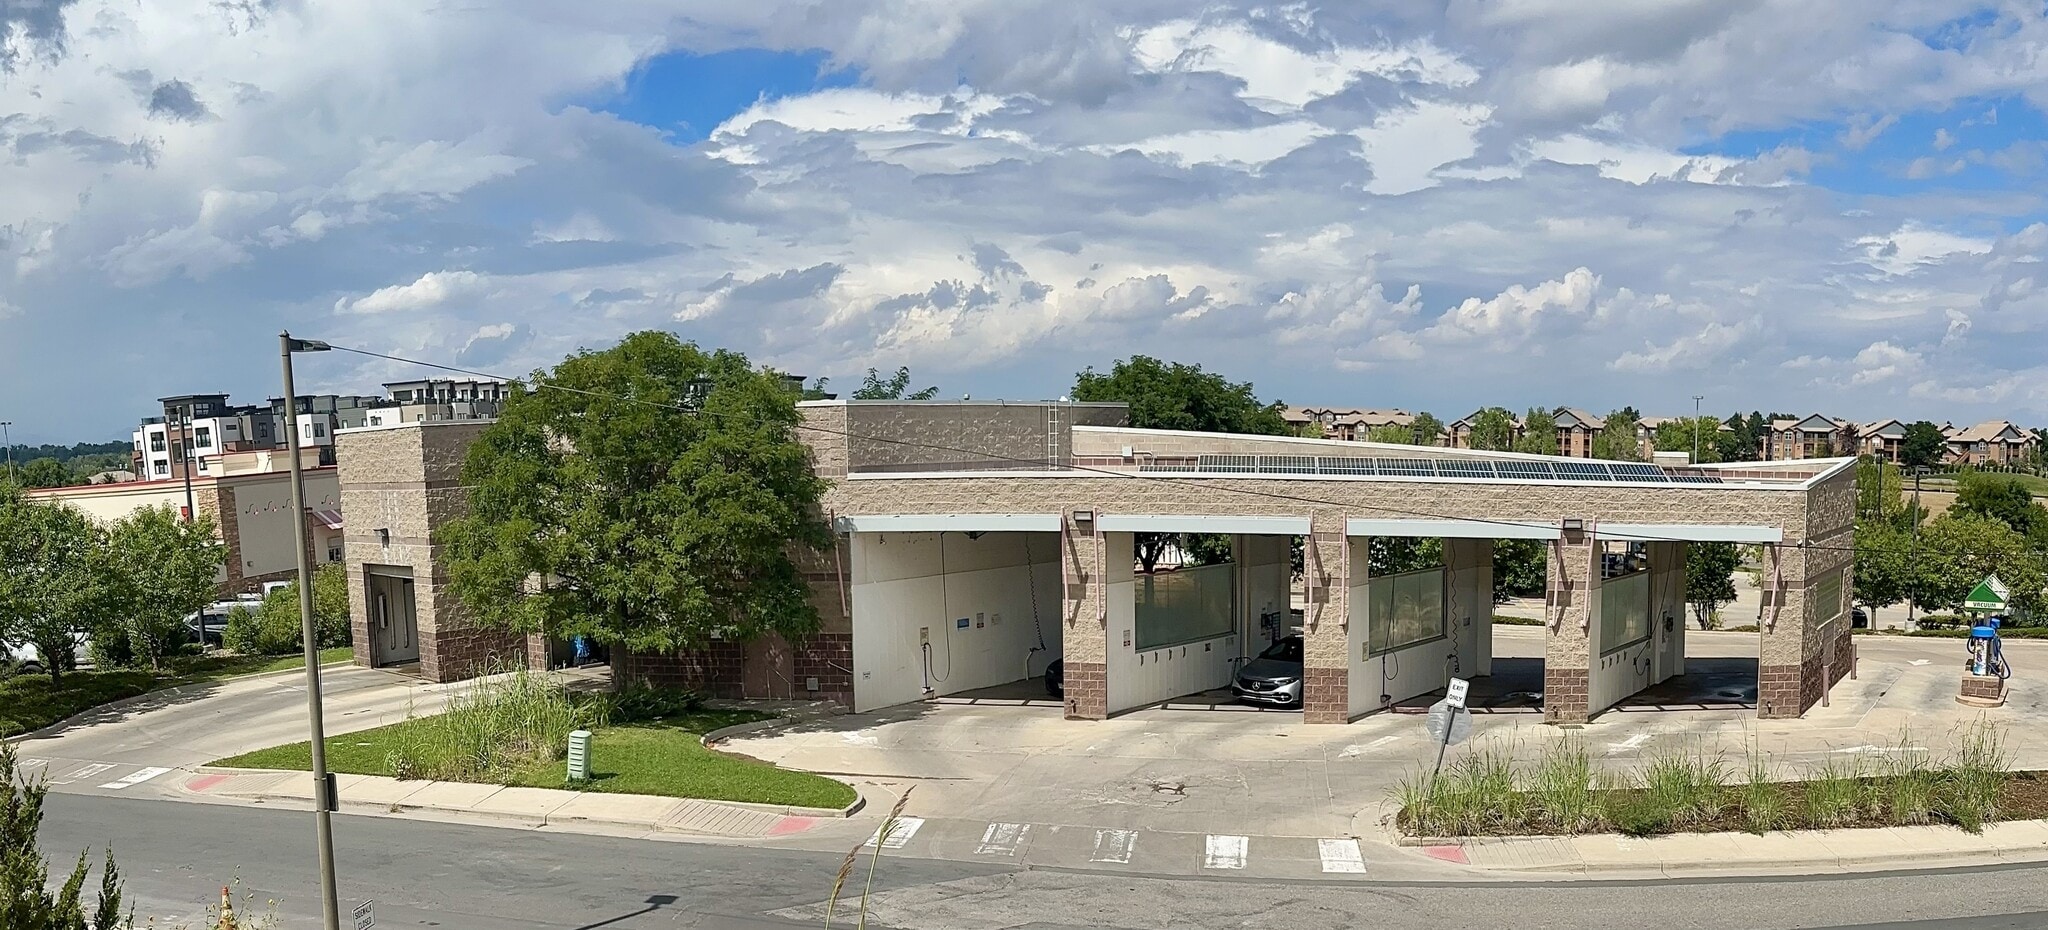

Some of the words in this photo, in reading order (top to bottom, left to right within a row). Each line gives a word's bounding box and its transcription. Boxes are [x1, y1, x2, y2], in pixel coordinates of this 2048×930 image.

[1452, 684, 1464, 692] EXIT
[1449, 694, 1463, 702] ONLY
[355, 904, 372, 920] SIDEWALK
[358, 916, 372, 929] CLOSED
